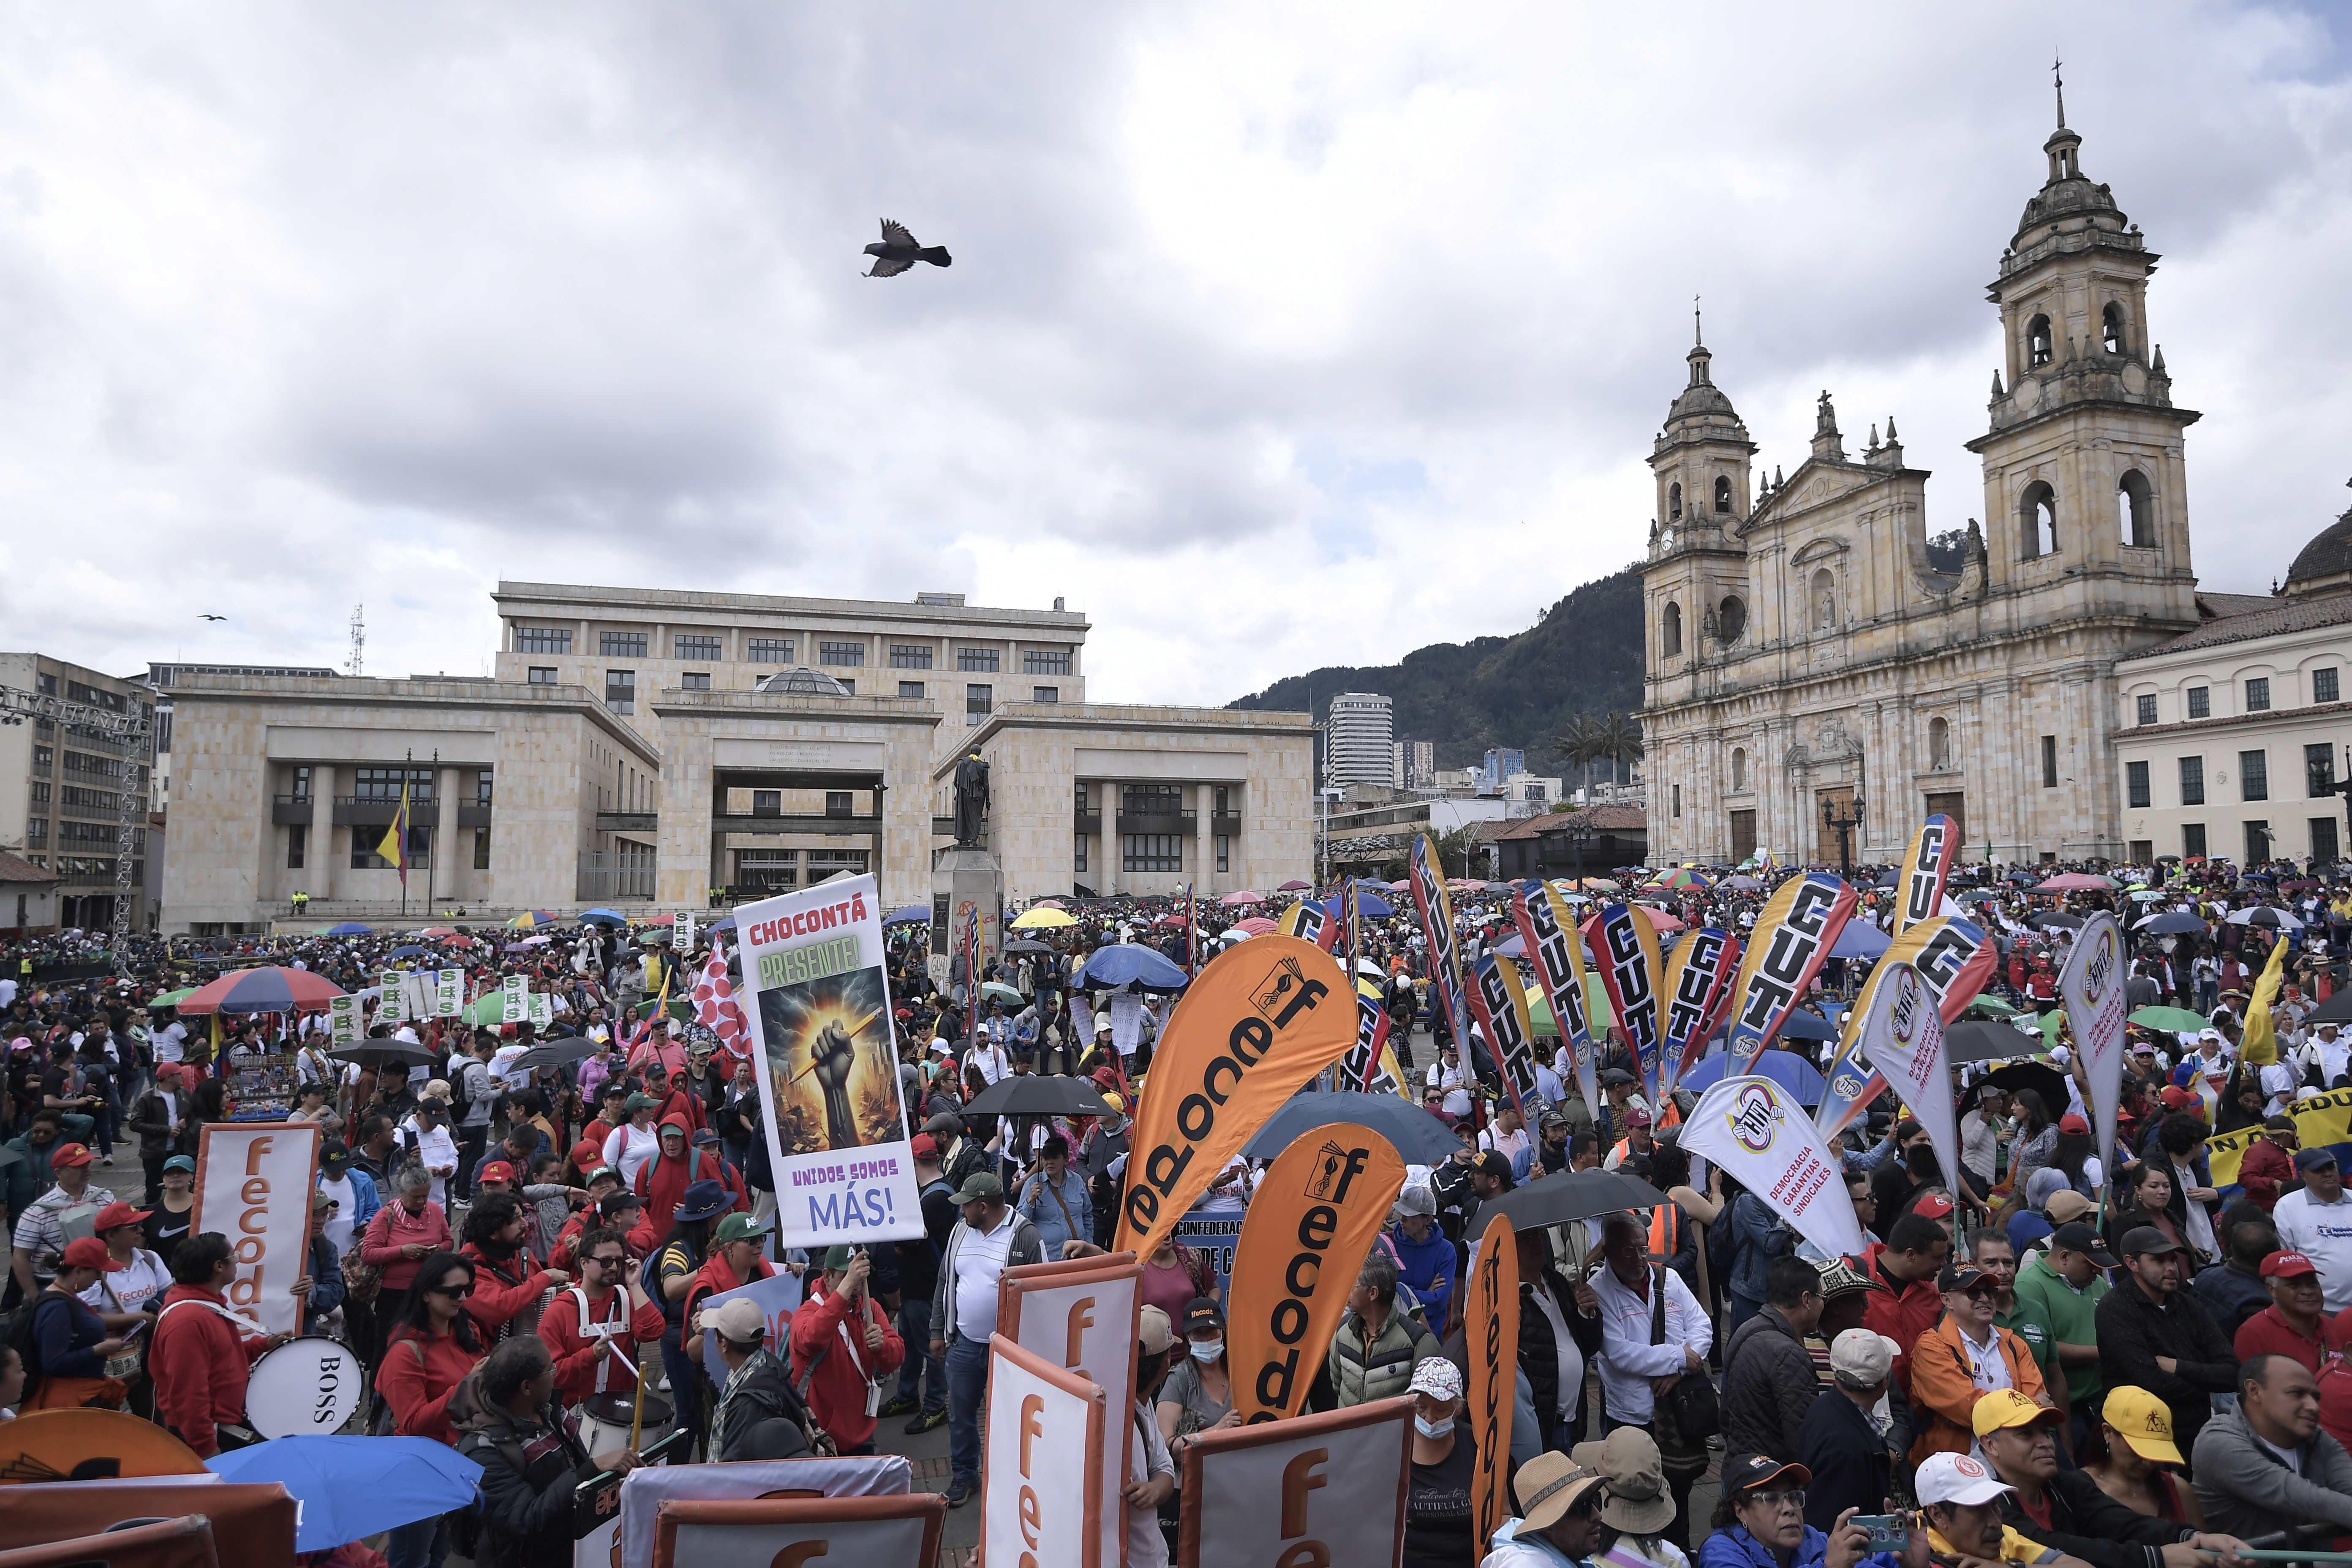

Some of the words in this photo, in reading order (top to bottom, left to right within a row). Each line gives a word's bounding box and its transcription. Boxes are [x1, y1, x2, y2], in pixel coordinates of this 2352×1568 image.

[675, 913, 688, 947] SES
[749, 892, 868, 947] CHOCONTÁ
[759, 934, 861, 989] PRESENTE!
[1525, 888, 1585, 1038] CUT
[1606, 912, 1657, 1048] CUT
[1740, 881, 1840, 1033] CUT
[382, 972, 401, 1019] SES
[438, 970, 456, 1013] SES
[505, 976, 521, 1019] SES
[1669, 934, 1725, 1041] CUT
[2088, 986, 2121, 1040] DEMOCRACIA
[1480, 961, 1538, 1096] CUT
[1908, 1011, 1933, 1078] DEMOCRACIA
[2092, 999, 2121, 1047] GARANTIAS
[2095, 1008, 2126, 1057] SINDICALES
[1915, 1022, 1937, 1081] GARANTIAS
[1919, 1029, 1944, 1090] SINDICALES
[1127, 979, 1329, 1235] fecode
[792, 1165, 846, 1187] UNIDOS
[850, 1158, 899, 1180] SOMOS
[1769, 1146, 1813, 1201] DEMOCRACIA
[1783, 1158, 1821, 1207] GARANTIAS
[1793, 1166, 1832, 1217] SINDICALES
[808, 1181, 896, 1232] MÁS!
[313, 1355, 342, 1425] BOSS
[1415, 1488, 1451, 1499] welcome
